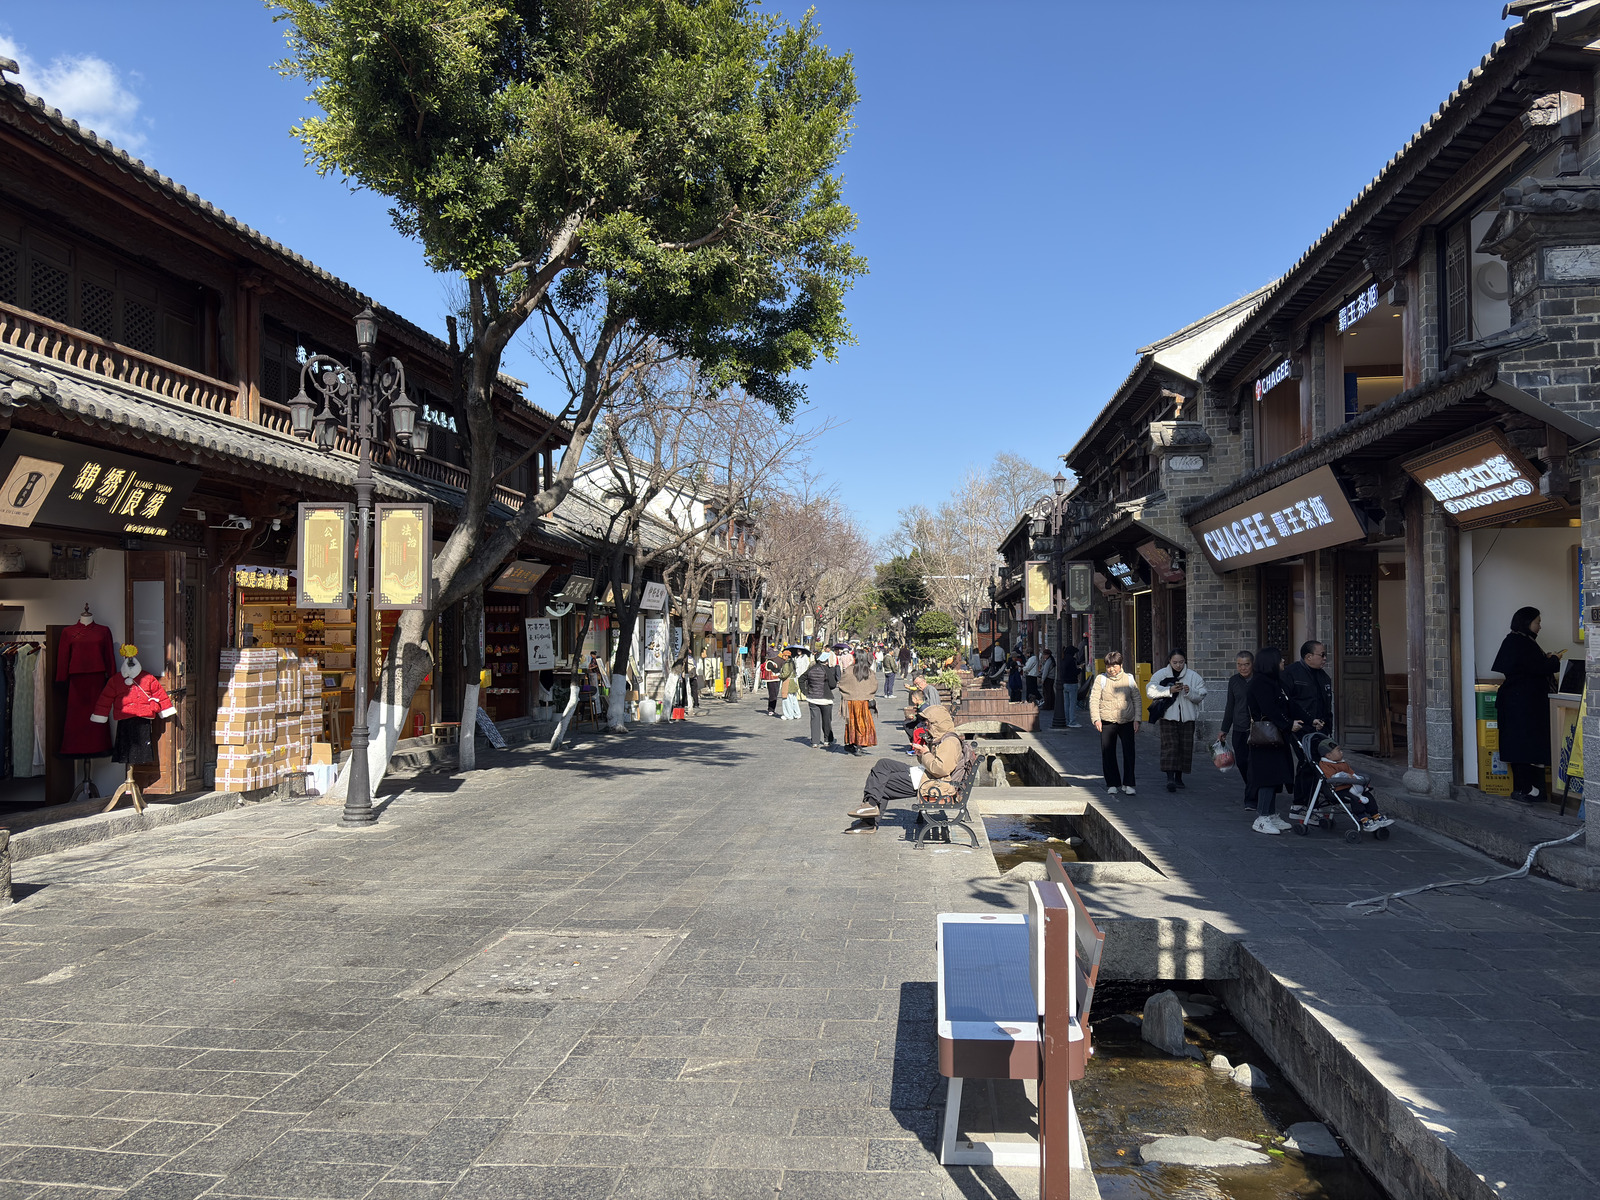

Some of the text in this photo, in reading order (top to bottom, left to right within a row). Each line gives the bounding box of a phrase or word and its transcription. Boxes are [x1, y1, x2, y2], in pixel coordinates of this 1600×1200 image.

[1338, 282, 1378, 332] 霸王茶姬
[1261, 359, 1292, 394] CHAGEE
[1424, 454, 1521, 501] 麒麟大口茶
[68, 492, 109, 505] JIN XIU
[1456, 484, 1520, 511] DAKOTEA
[324, 526, 338, 550] 公正
[401, 523, 417, 549] 法治
[1203, 495, 1334, 562] CHAGEE 霸王茶姬
